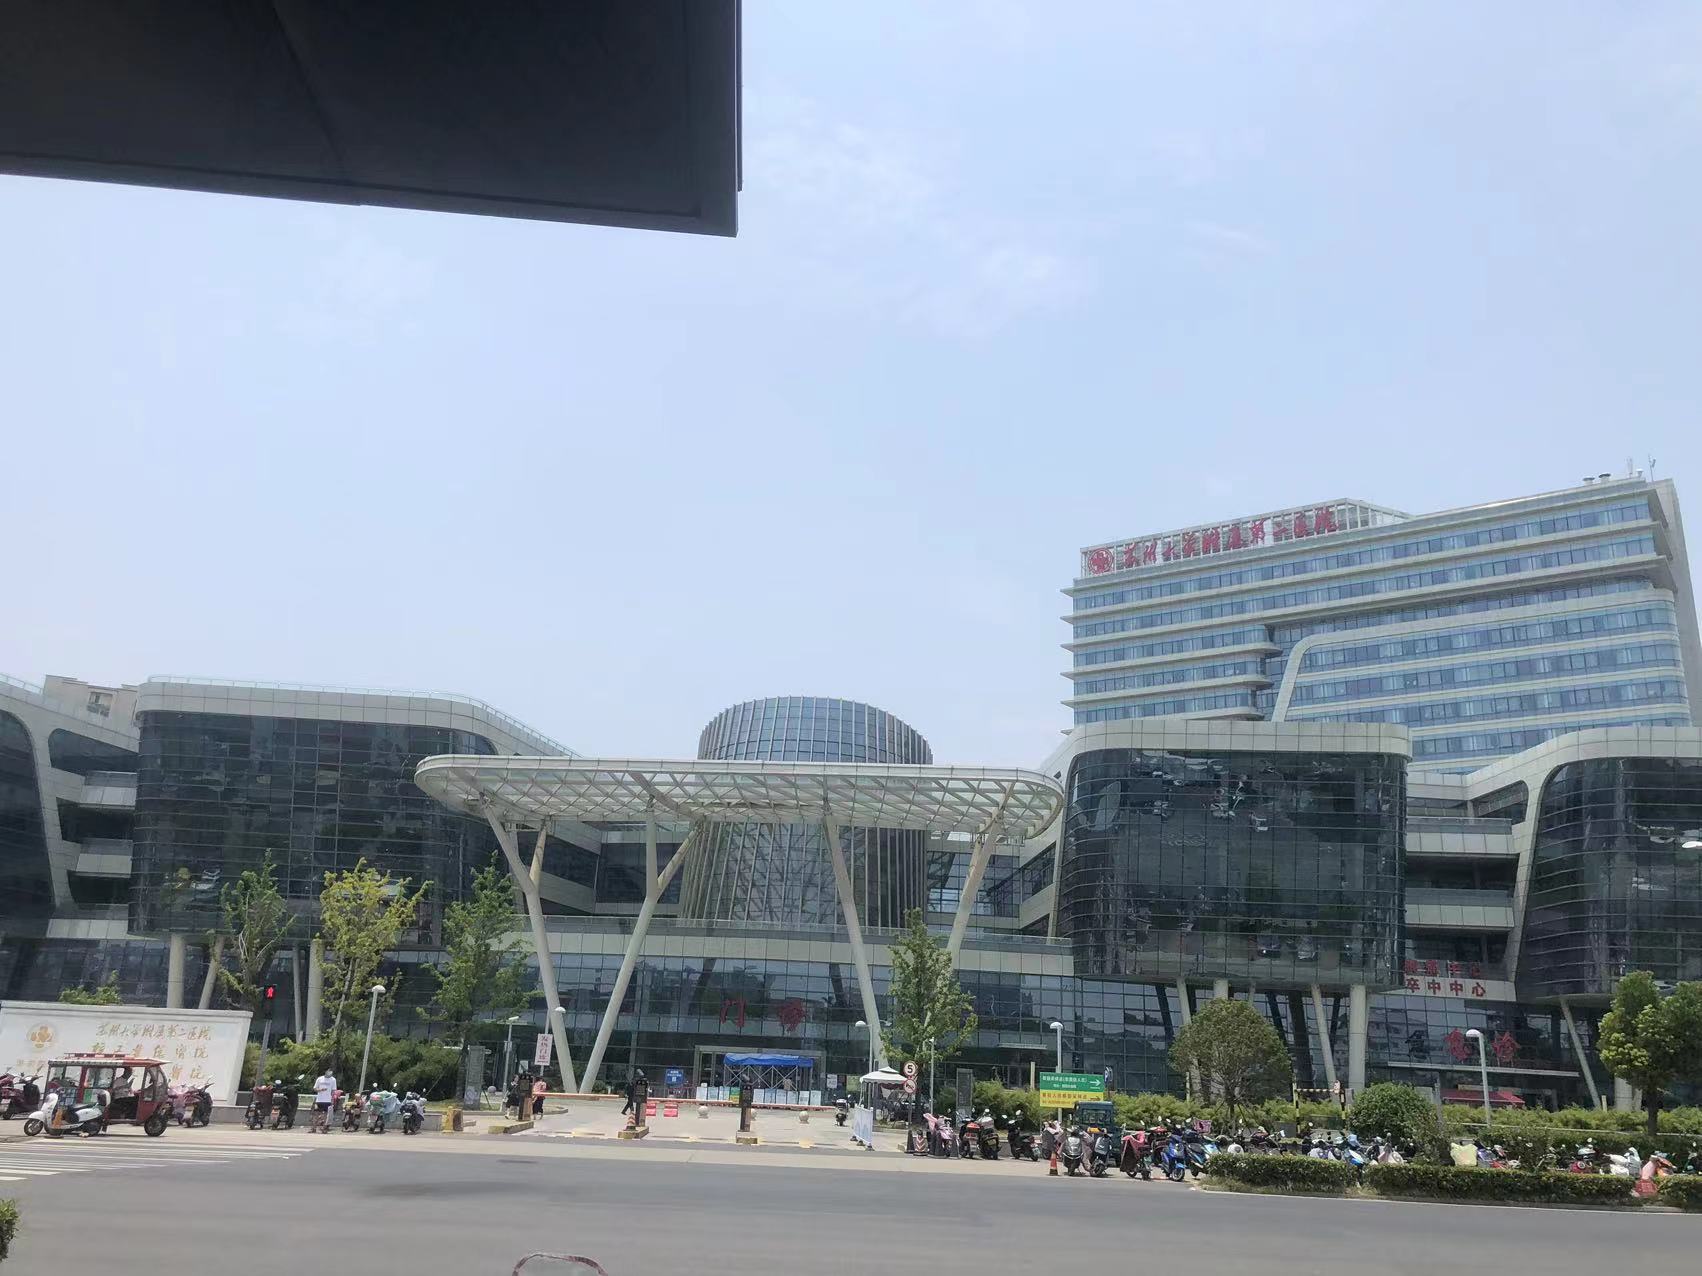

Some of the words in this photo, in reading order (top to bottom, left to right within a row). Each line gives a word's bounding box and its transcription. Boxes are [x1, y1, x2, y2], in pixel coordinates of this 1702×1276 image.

[1406, 977, 1486, 997] 卒中中心
[907, 1064, 913, 1073] 5
